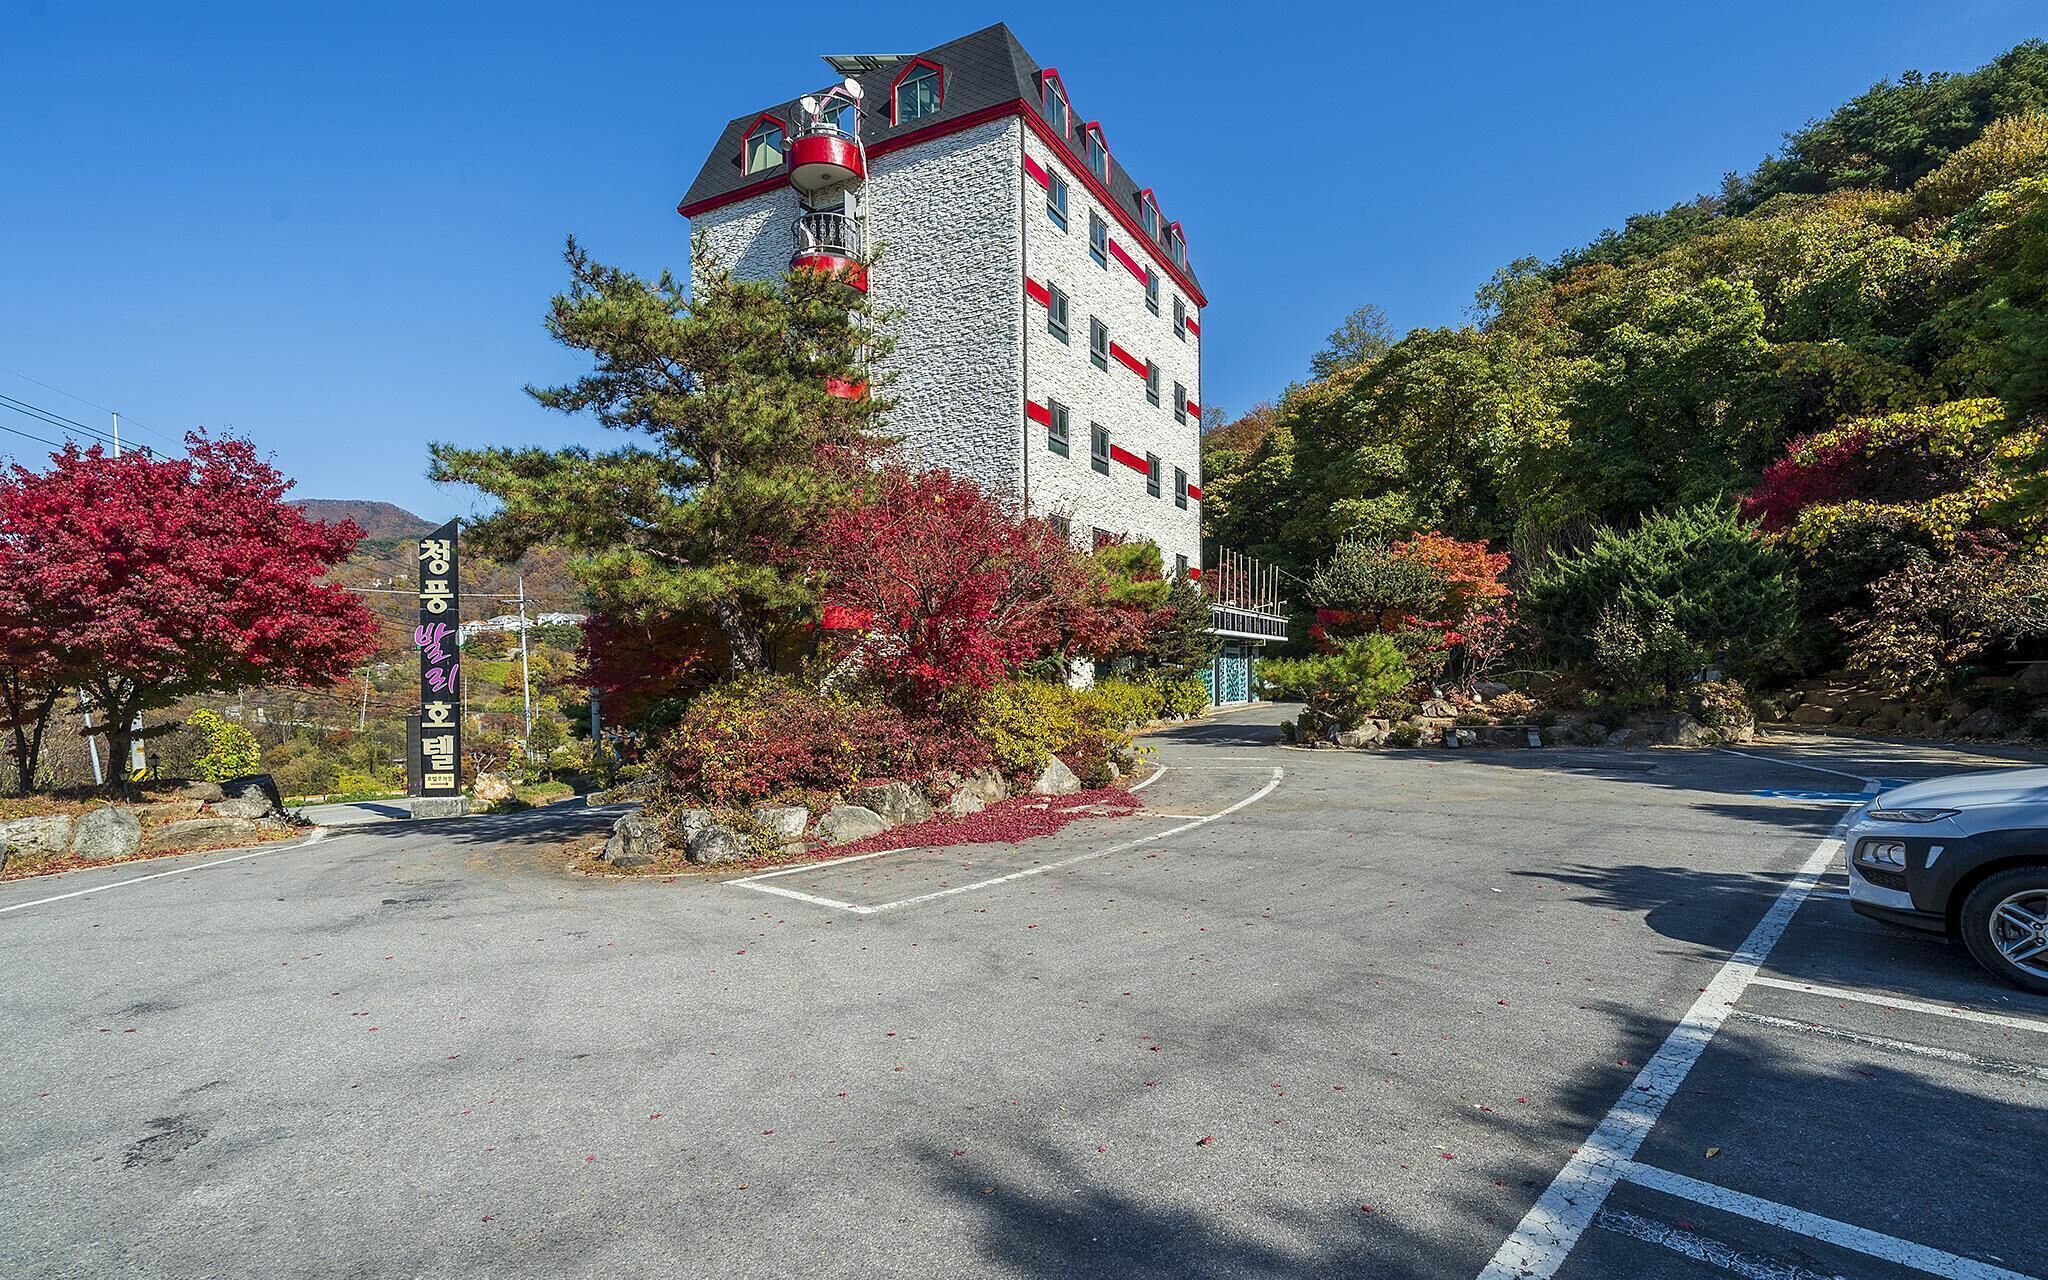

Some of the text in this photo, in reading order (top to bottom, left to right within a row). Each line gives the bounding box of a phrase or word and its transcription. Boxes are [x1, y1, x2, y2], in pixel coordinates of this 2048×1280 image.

[414, 539, 459, 770] 청풍 발리 호텔
